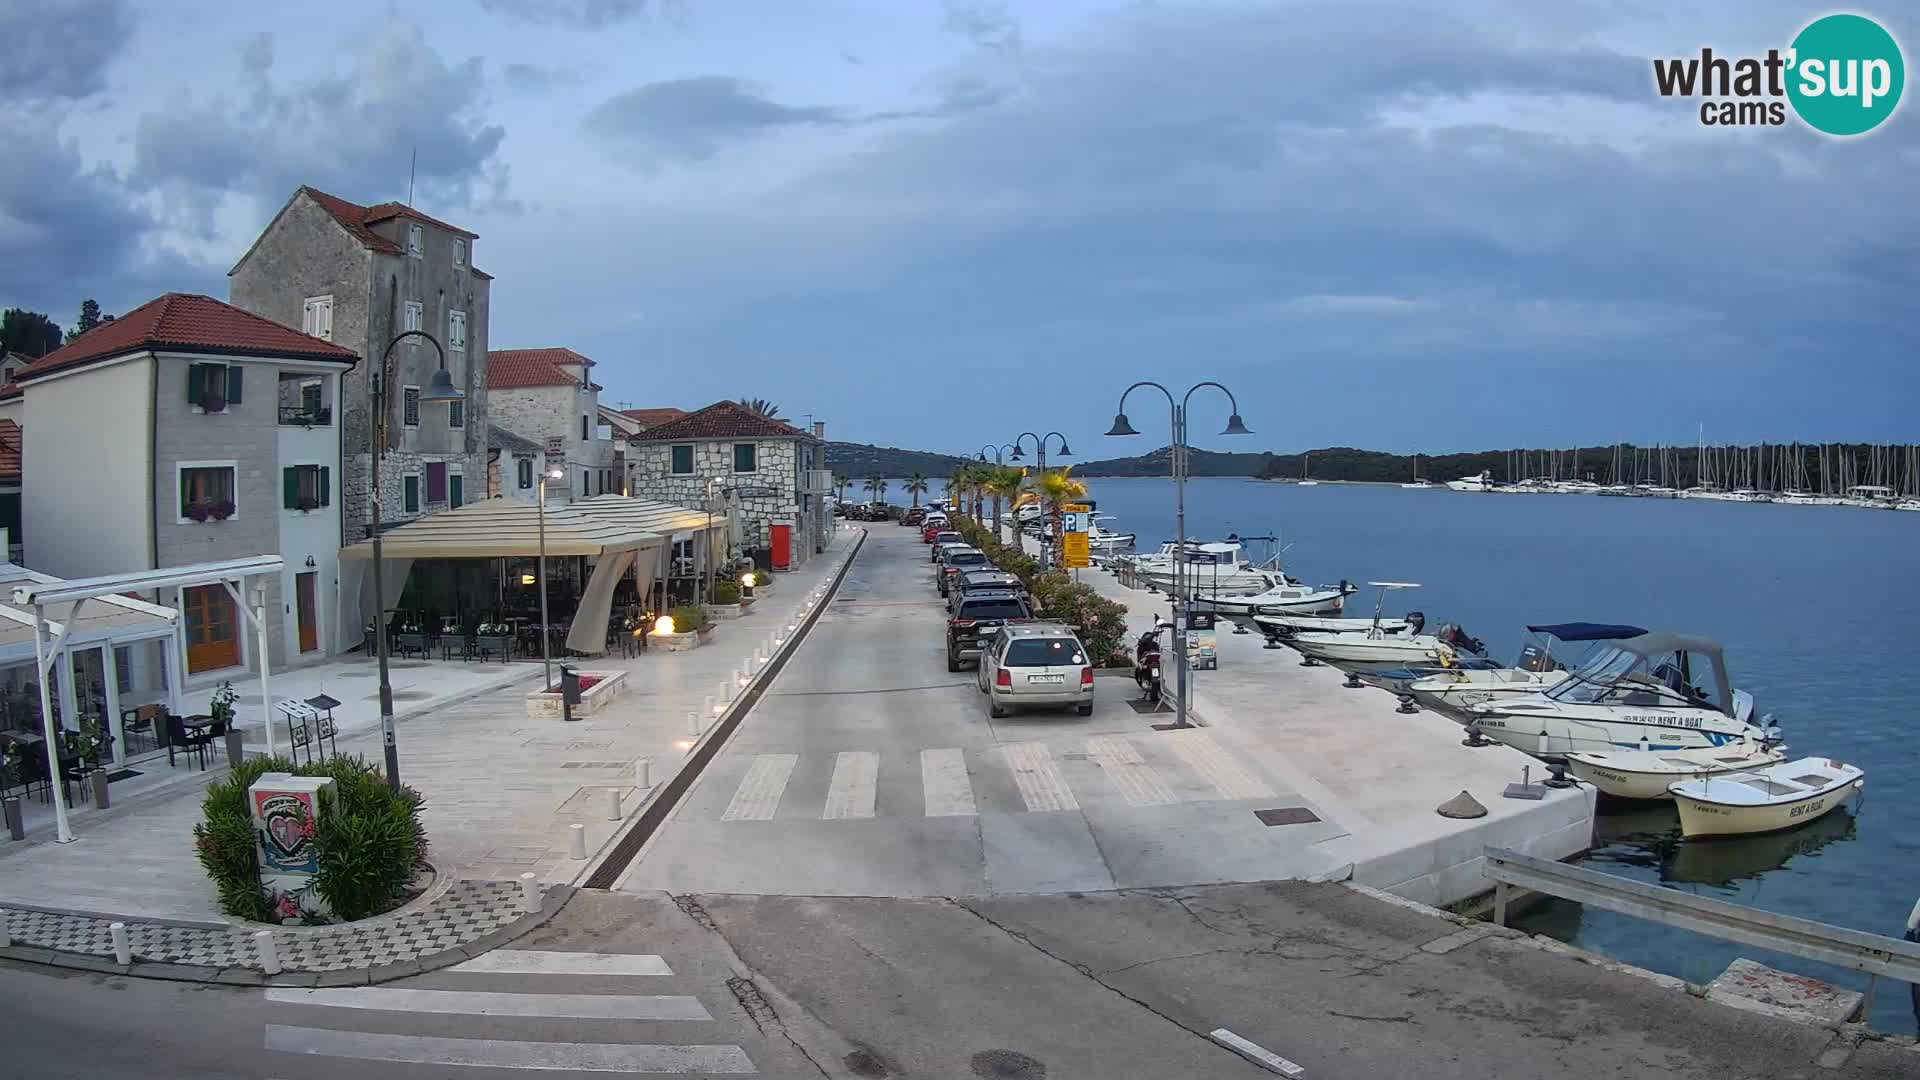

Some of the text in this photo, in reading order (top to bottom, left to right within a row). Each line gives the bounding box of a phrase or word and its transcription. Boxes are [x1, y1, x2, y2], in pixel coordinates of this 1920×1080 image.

[1065, 514, 1076, 531] P
[1657, 716, 1677, 725] RENT
[1678, 717, 1683, 727] A
[1684, 717, 1703, 728] BOAT
[1789, 804, 1806, 817] RENT
[1811, 799, 1825, 811] BOAT
